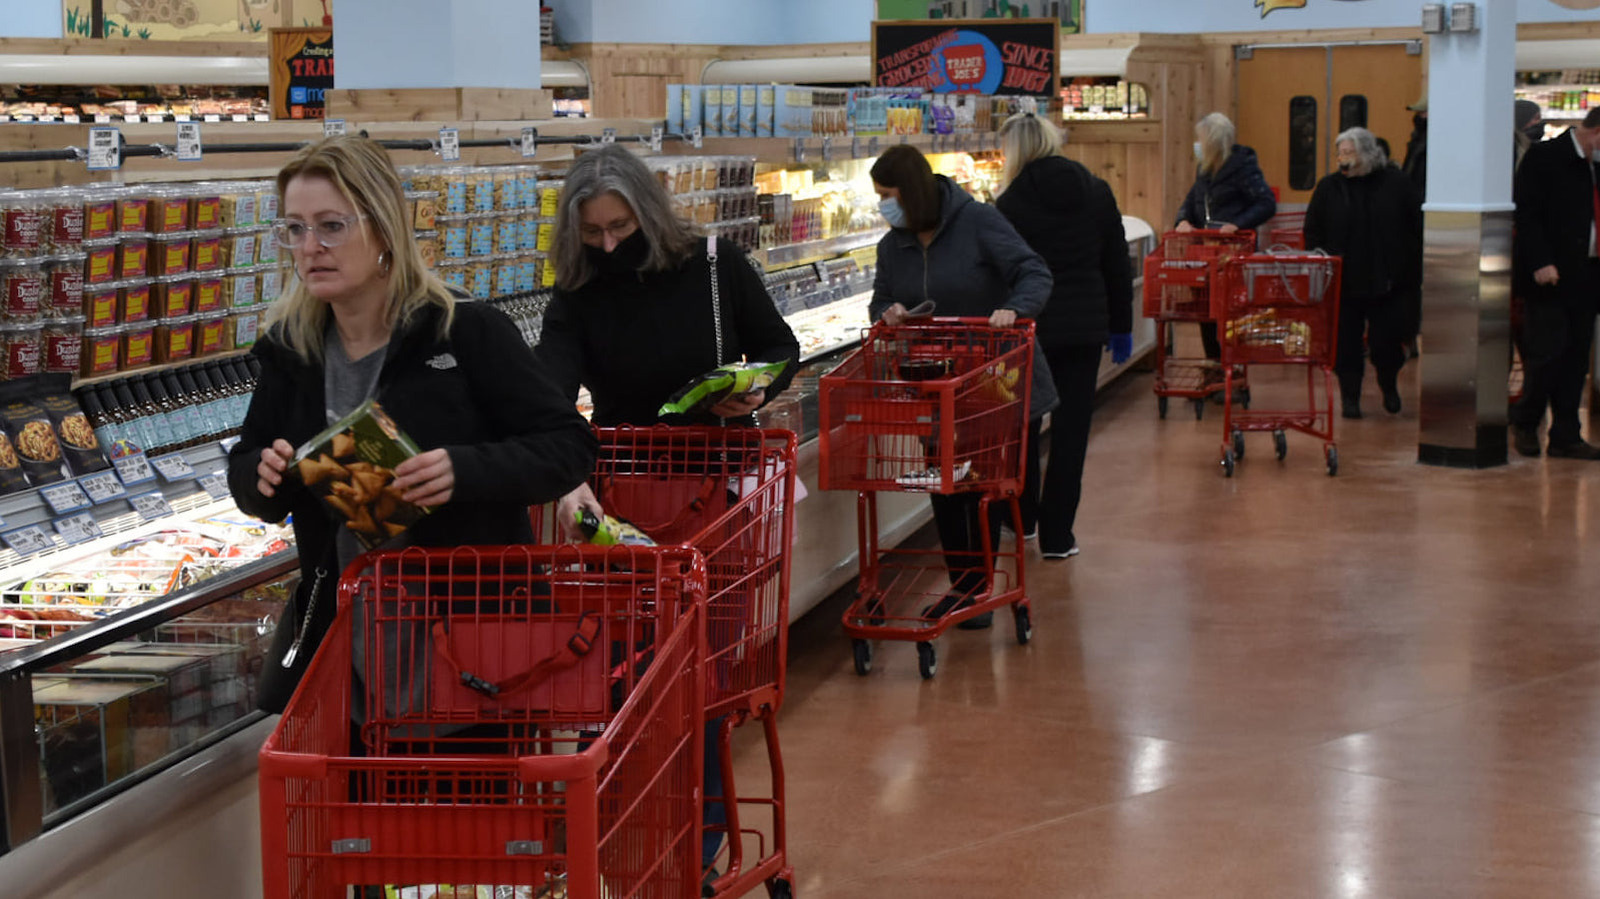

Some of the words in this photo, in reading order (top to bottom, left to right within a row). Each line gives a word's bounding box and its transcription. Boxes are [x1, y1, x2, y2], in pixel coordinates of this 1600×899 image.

[946, 56, 982, 69] TRADER
[1001, 40, 1056, 71] SINCE
[878, 53, 942, 87] GROCERY
[952, 68, 980, 80] JOE'S
[1002, 66, 1052, 93] 1967
